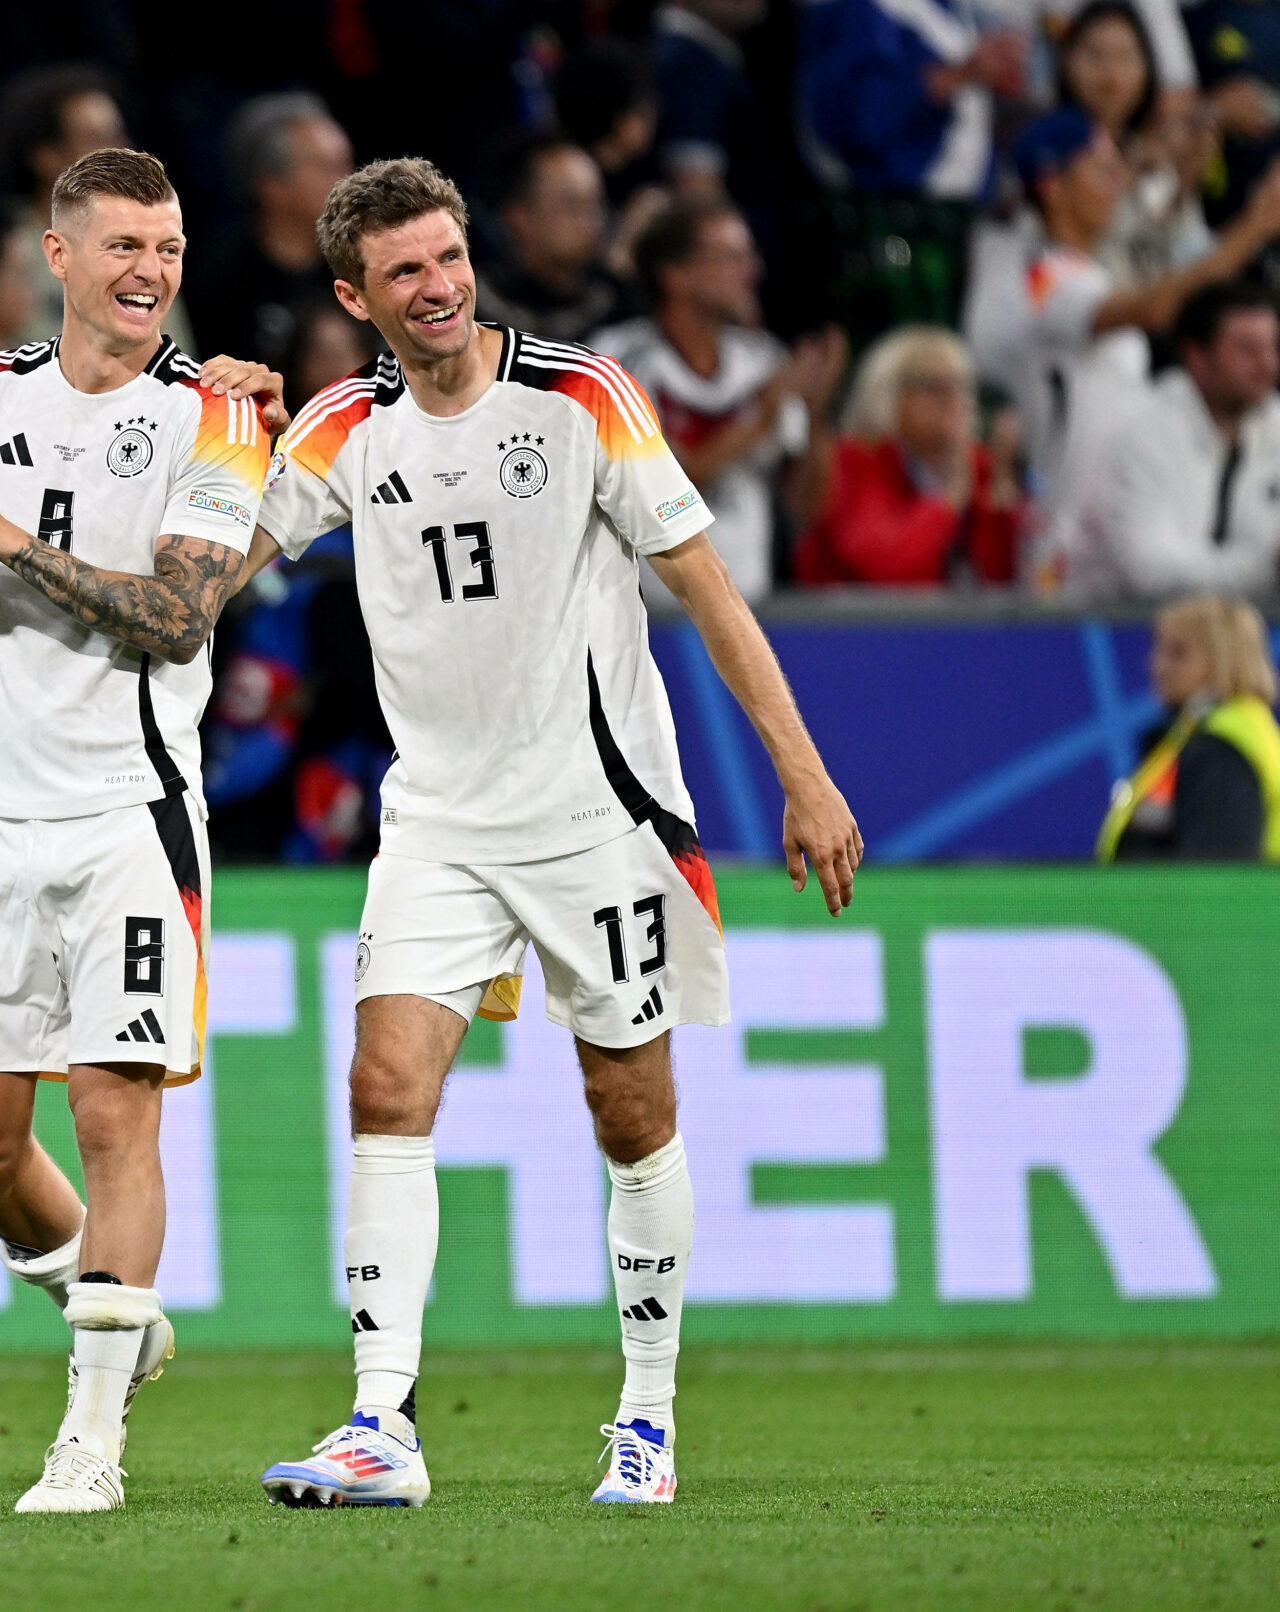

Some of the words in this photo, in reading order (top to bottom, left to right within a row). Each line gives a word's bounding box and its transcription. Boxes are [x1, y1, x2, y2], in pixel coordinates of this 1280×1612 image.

[37, 487, 76, 556] 8
[188, 495, 251, 522] FOUNDATION
[420, 520, 499, 603] 13
[124, 915, 166, 998] 8
[593, 893, 667, 985] 13
[345, 1264, 381, 1284] FB
[617, 1253, 676, 1275] DFB
